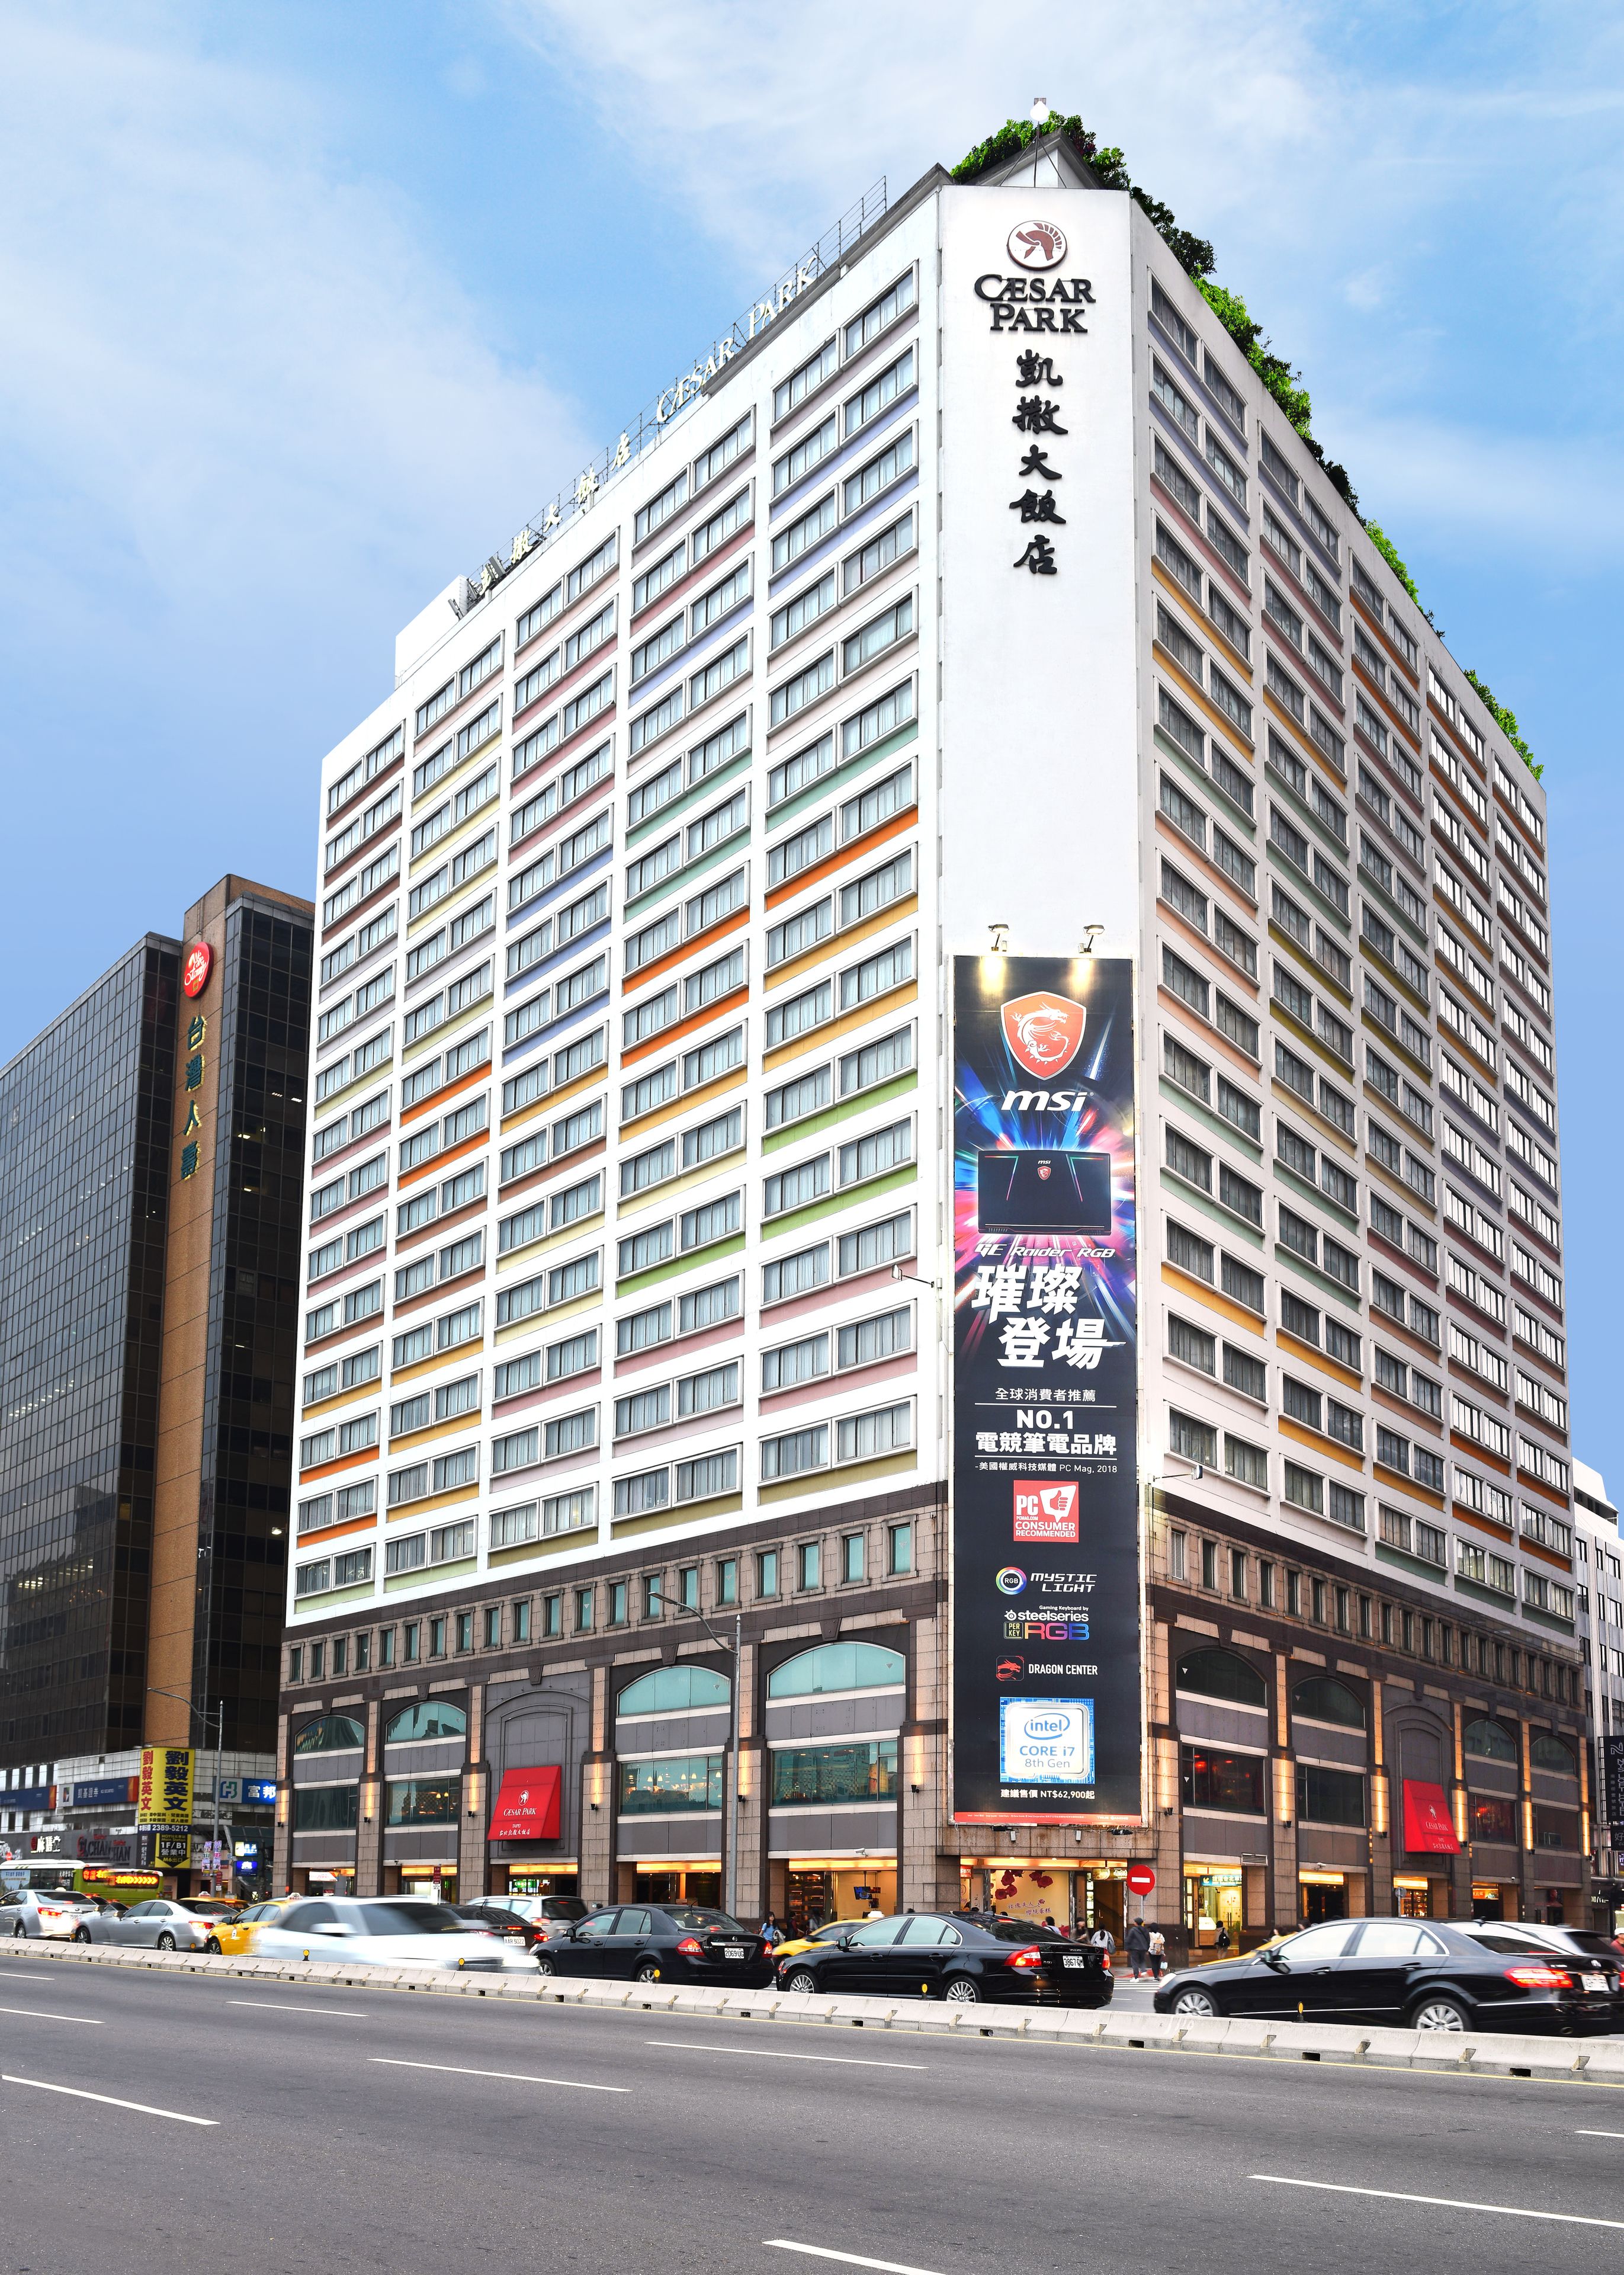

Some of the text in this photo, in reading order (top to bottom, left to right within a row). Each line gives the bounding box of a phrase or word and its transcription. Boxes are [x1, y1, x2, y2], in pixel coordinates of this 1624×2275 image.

[747, 255, 817, 340] PARK
[989, 303, 1088, 332] PARK
[1009, 349, 1068, 574] 凱撒大飯店
[181, 1014, 207, 1180] 台灣人壽
[1001, 1090, 1089, 1112] msi
[975, 1244, 1116, 1258] GE Raider RGB
[971, 1263, 1083, 1324] 璀璨
[997, 1316, 1126, 1370] 登場
[995, 1388, 1096, 1402] 全球消費者推薦
[1016, 1409, 1074, 1430] NO.1
[975, 1432, 1117, 1455] 電競筆電品牌
[1074, 1465, 1095, 1475] Mag,
[1097, 1465, 1118, 1473] 2018
[1016, 1495, 1038, 1516] PC
[1015, 1521, 1076, 1531] CONSUMER
[1030, 1573, 1097, 1582] MYSTIC
[1042, 1584, 1095, 1592] LIGHT
[1018, 1610, 1089, 1622] steelseries
[1025, 1622, 1090, 1640] RGB
[1028, 1664, 1098, 1675] DRAGON CENTER
[1030, 1719, 1062, 1732] intel
[1019, 1746, 1075, 1757] CORE i7
[1025, 1758, 1070, 1768] 8th Gen
[140, 1750, 153, 1811] 劉毅英文
[163, 1751, 189, 1811] 劉毅英文
[248, 1785, 276, 1799] 富邦
[1000, 1789, 1095, 1799] 建議售價 NT$62,900起
